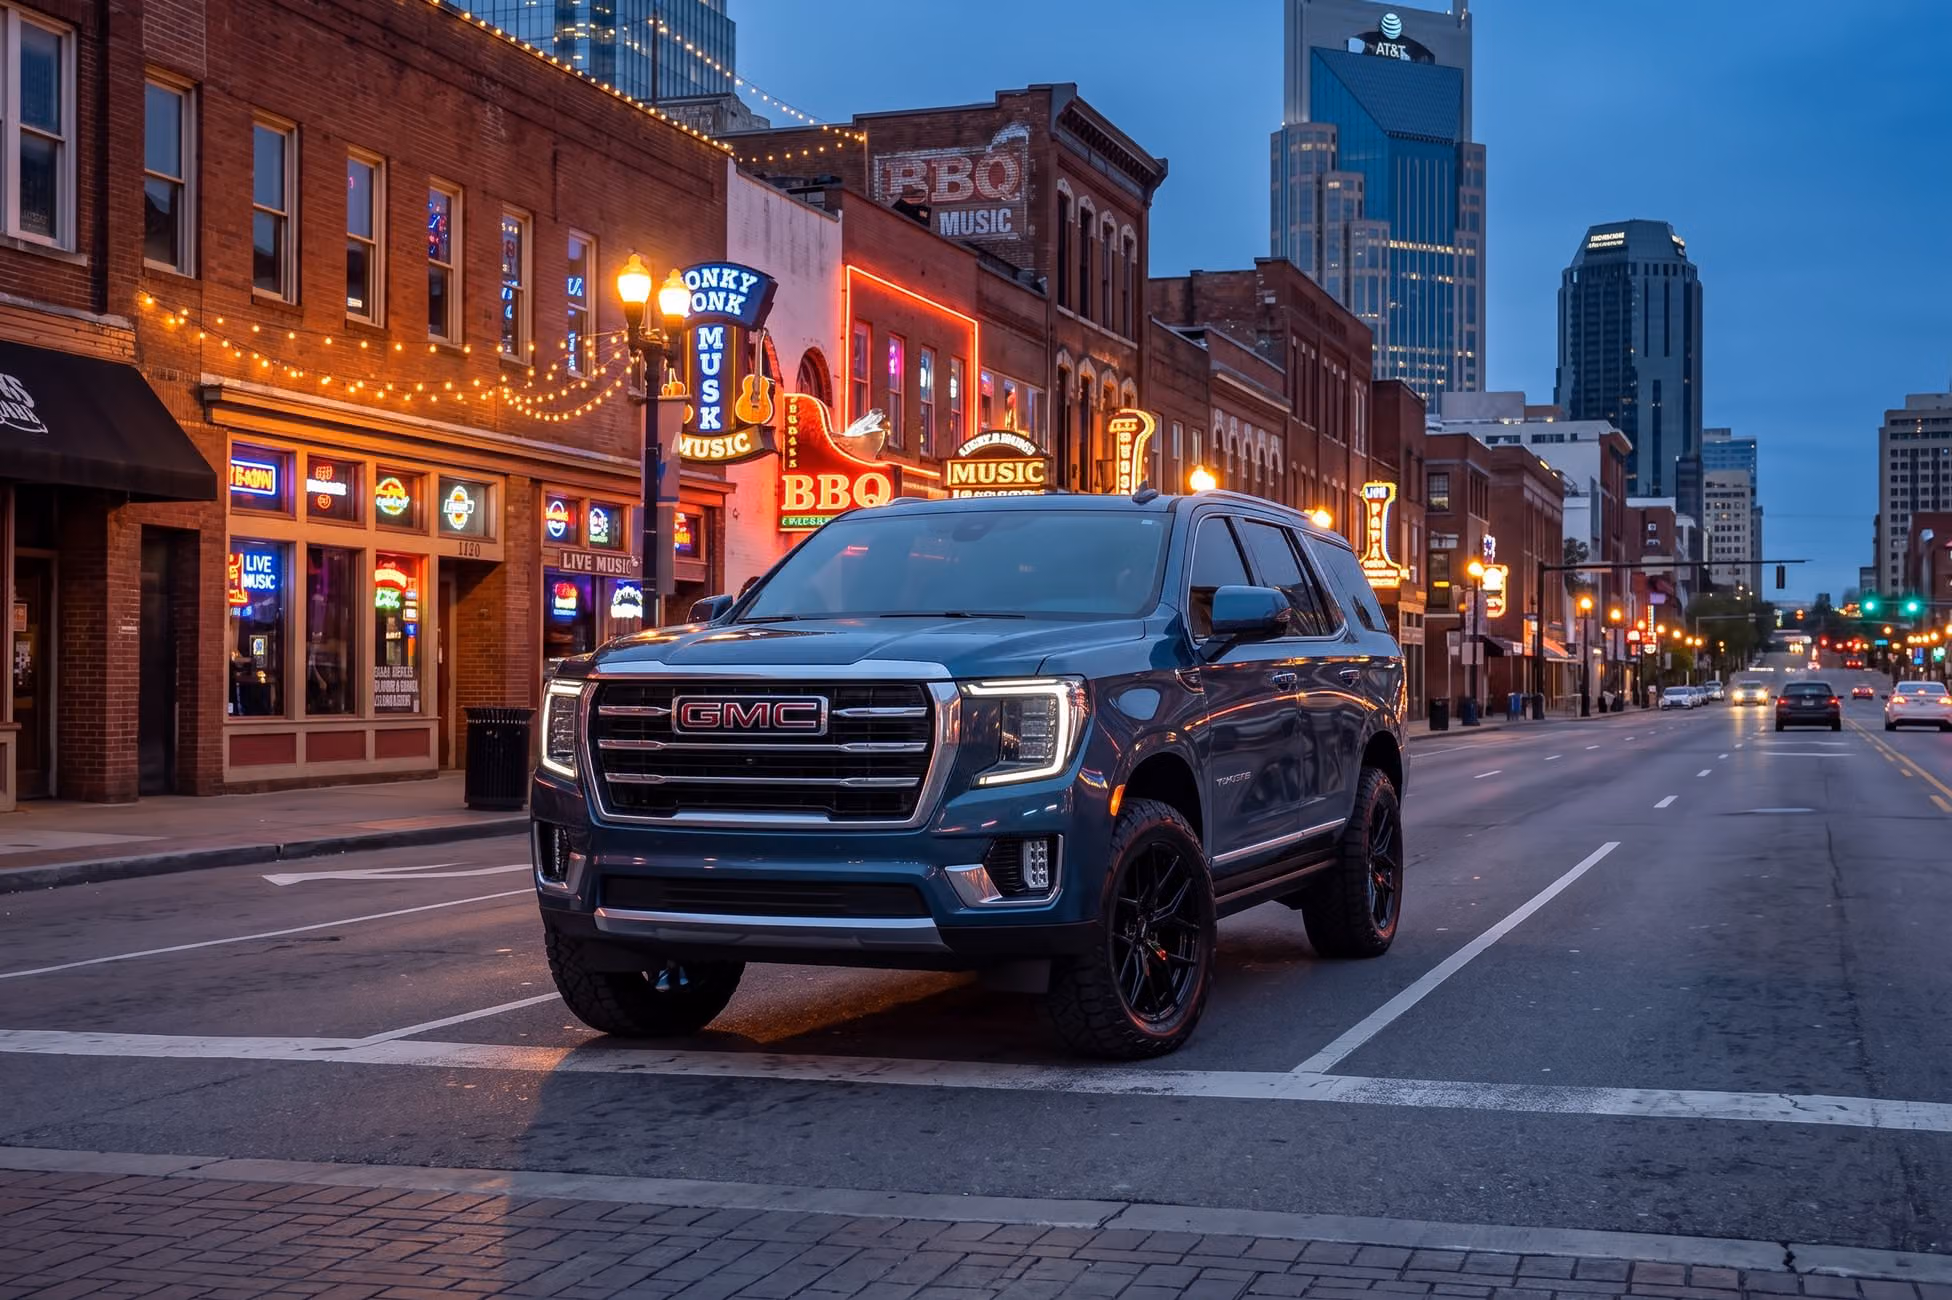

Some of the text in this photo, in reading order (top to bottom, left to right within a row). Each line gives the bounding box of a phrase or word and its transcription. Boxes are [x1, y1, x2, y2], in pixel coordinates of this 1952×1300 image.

[1376, 42, 1407, 58] AT&T
[883, 156, 1021, 204] BBQ
[939, 208, 1012, 236] MUSIC
[684, 267, 759, 295] ONKY
[686, 291, 747, 317] ONK
[678, 432, 751, 458] MUSIC
[951, 462, 1045, 484] MUSIC
[781, 472, 891, 511] BBQ
[246, 555, 272, 572] LIVE
[563, 552, 632, 574] LIVE MUSIC
[243, 573, 275, 590] MUSIC
[681, 702, 817, 728] GMC
